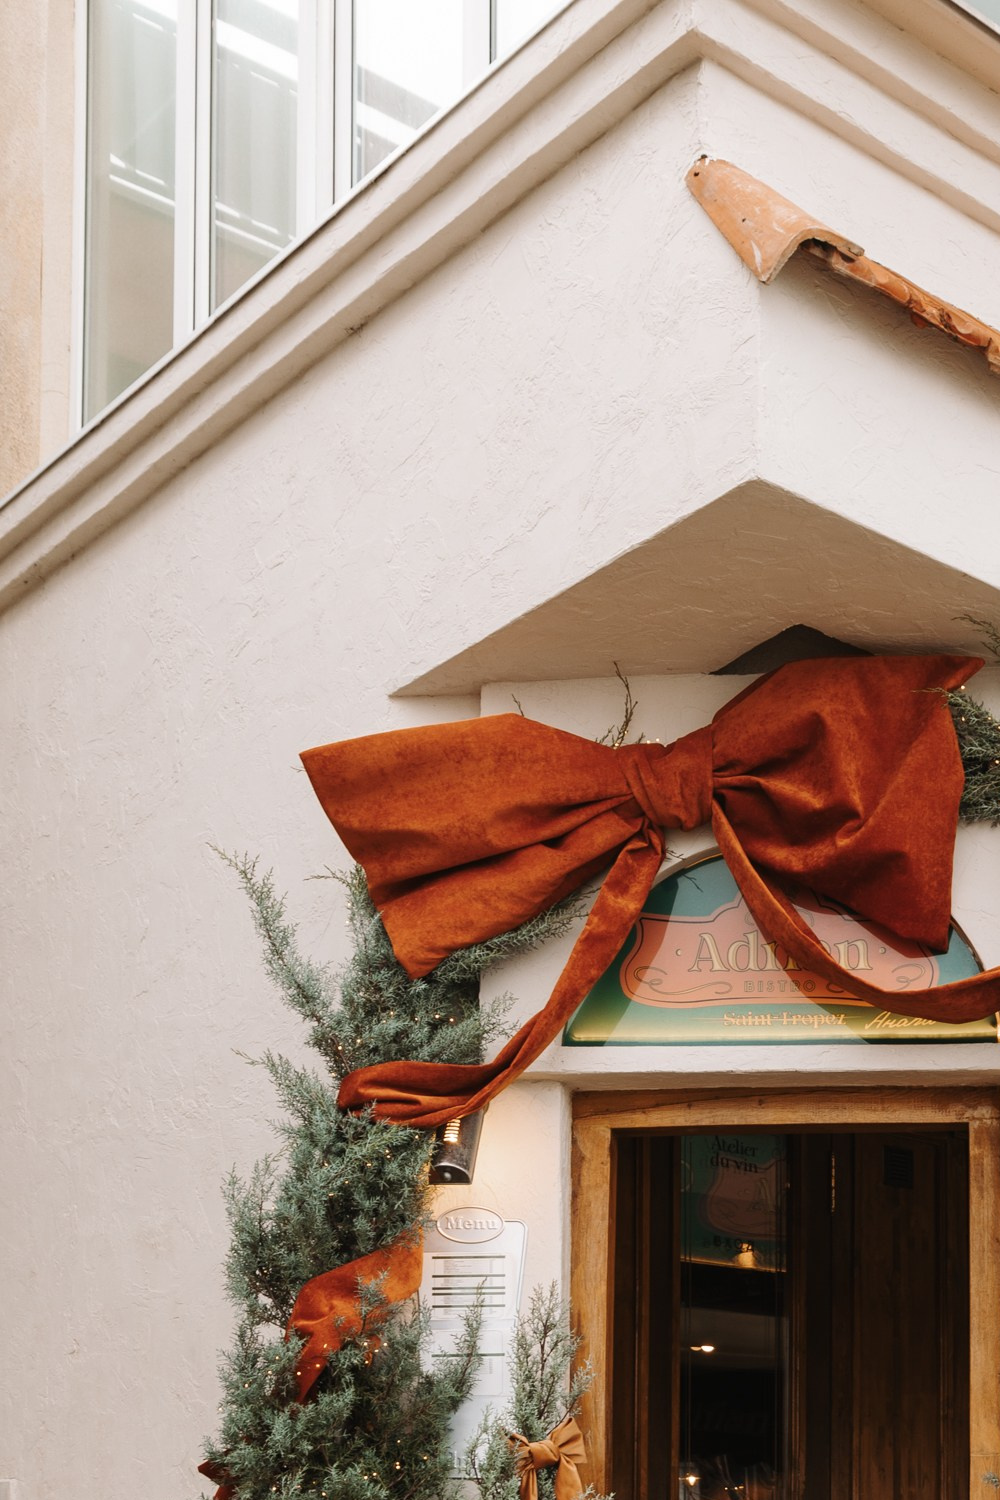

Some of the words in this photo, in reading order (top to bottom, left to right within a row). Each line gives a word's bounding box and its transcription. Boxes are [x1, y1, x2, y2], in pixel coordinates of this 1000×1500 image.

[743, 979, 817, 993] BISTRO
[723, 1010, 846, 1029] Saint-Tropez
[711, 1135, 759, 1157] Atelier
[732, 1158, 758, 1173] vin
[445, 1216, 499, 1231] Menu
